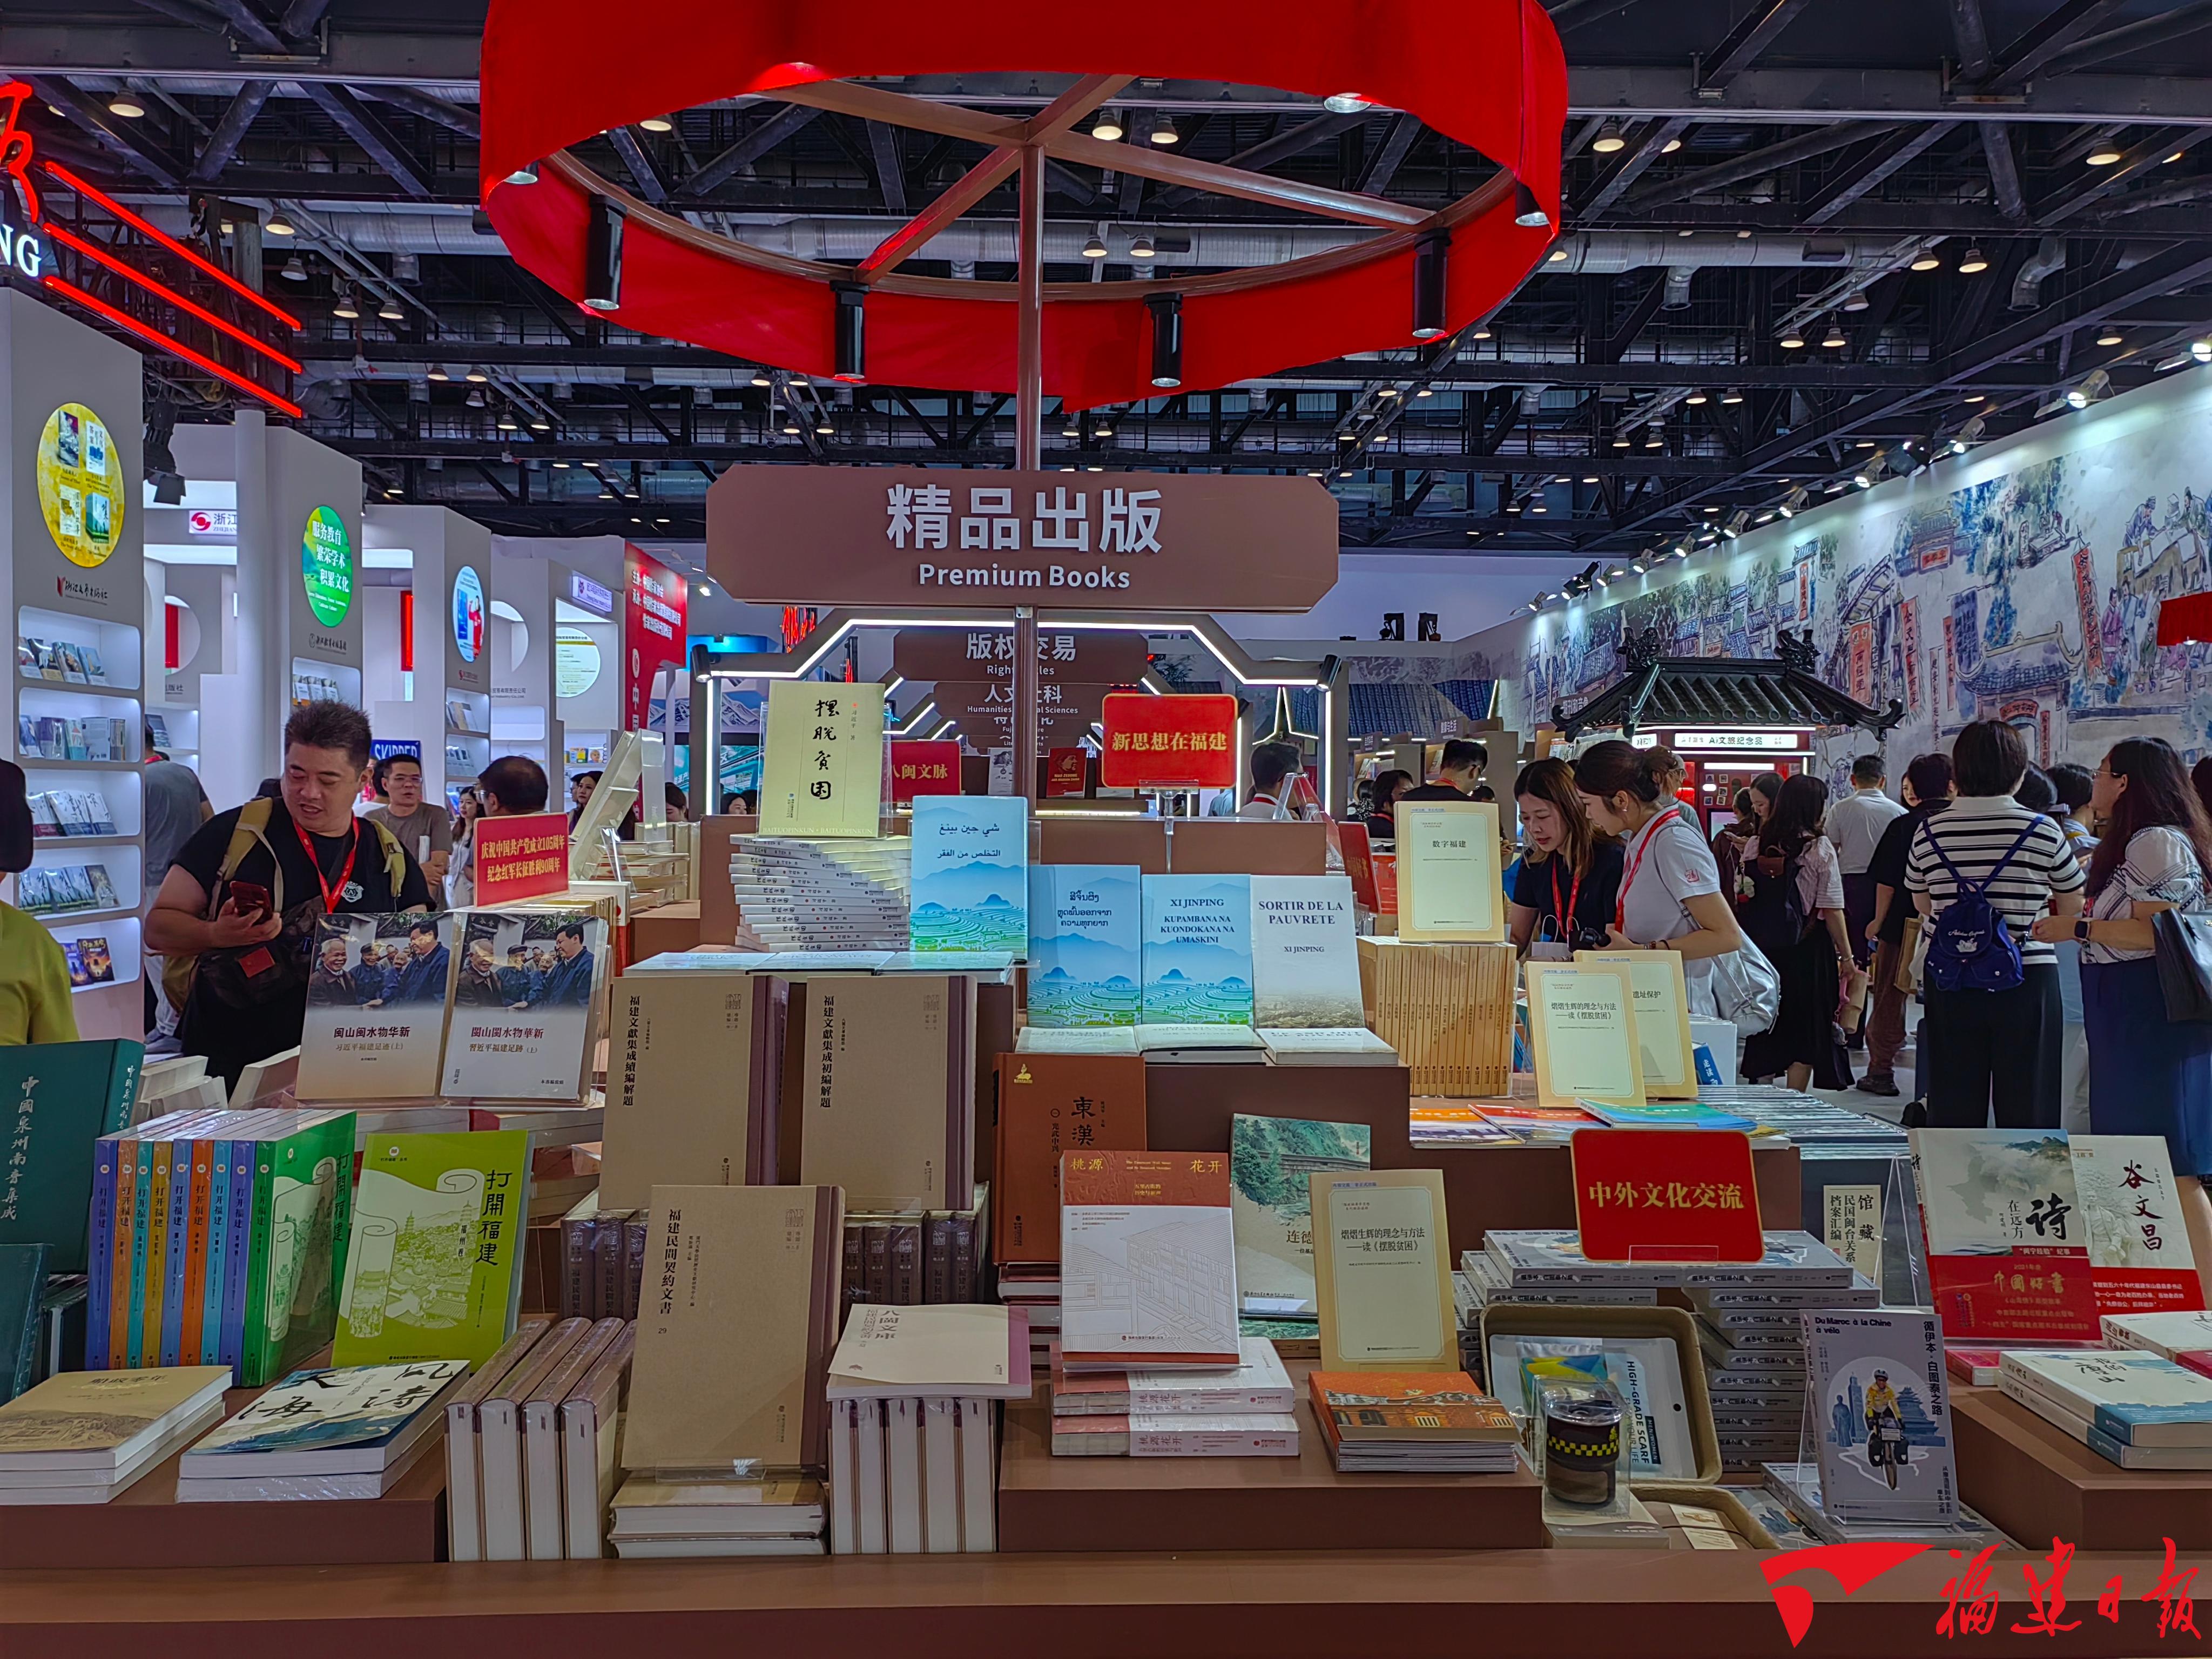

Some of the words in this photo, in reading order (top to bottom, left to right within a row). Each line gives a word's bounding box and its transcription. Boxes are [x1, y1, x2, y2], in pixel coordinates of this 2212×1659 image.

[213, 512, 237, 525] 浙江
[886, 484, 1162, 554] 精品出版
[312, 520, 341, 545] 服务教育
[316, 544, 346, 569] 繁荣学术
[320, 568, 349, 593] 积累文化
[919, 563, 1041, 587] Premium
[1049, 565, 1130, 589] Books
[810, 699, 839, 800] 摆脱贫困
[1111, 731, 1228, 751] 新思想在福建
[482, 835, 565, 860] 庆祝中国共产党成立105周年
[487, 857, 561, 883] 纪念红军长征胜利90周年
[1170, 899, 1181, 907] XI
[1183, 899, 1224, 907] JINPING
[1258, 901, 1304, 911] SORTIR
[1308, 901, 1324, 911] DE
[1327, 901, 1344, 911] LA
[1269, 914, 1336, 925] PAUVRETE
[334, 1026, 410, 1038] 闽山闽水物华新
[1071, 1096, 1096, 1146] 東漢
[1, 1075, 39, 1220] 中國泉州南音集成
[1070, 1157, 1103, 1171] 桃源
[1190, 1159, 1223, 1174] 花开
[1589, 1181, 1745, 1210] 中外文化交流
[2117, 1159, 2163, 1251] 谷文昌
[475, 1169, 512, 1266] 打開福建
[1830, 1195, 1842, 1240] 档案汇编
[1844, 1195, 1856, 1263] 民国闽台关系
[1858, 1194, 1874, 1241] 馆藏
[2007, 1199, 2024, 1239] 在远方
[2025, 1192, 2072, 1240] 诗
[457, 1224, 467, 1258] 福州卷
[1341, 1227, 1425, 1240] 熠熠生辉的理念与方法
[660, 1209, 682, 1314] 福建民間契約文書
[1815, 1317, 1825, 1325] Du
[1826, 1317, 1851, 1326] Maroc
[1860, 1318, 1868, 1326] la
[1870, 1319, 1892, 1327] Chine
[1824, 1326, 1840, 1334] vélo
[1626, 1361, 1644, 1427] HIGH-GRADE
[1637, 1429, 1649, 1464] SCARF
[1647, 1419, 1658, 1461] MEN/WOMEN
[1631, 1449, 1639, 1464] LIFE
